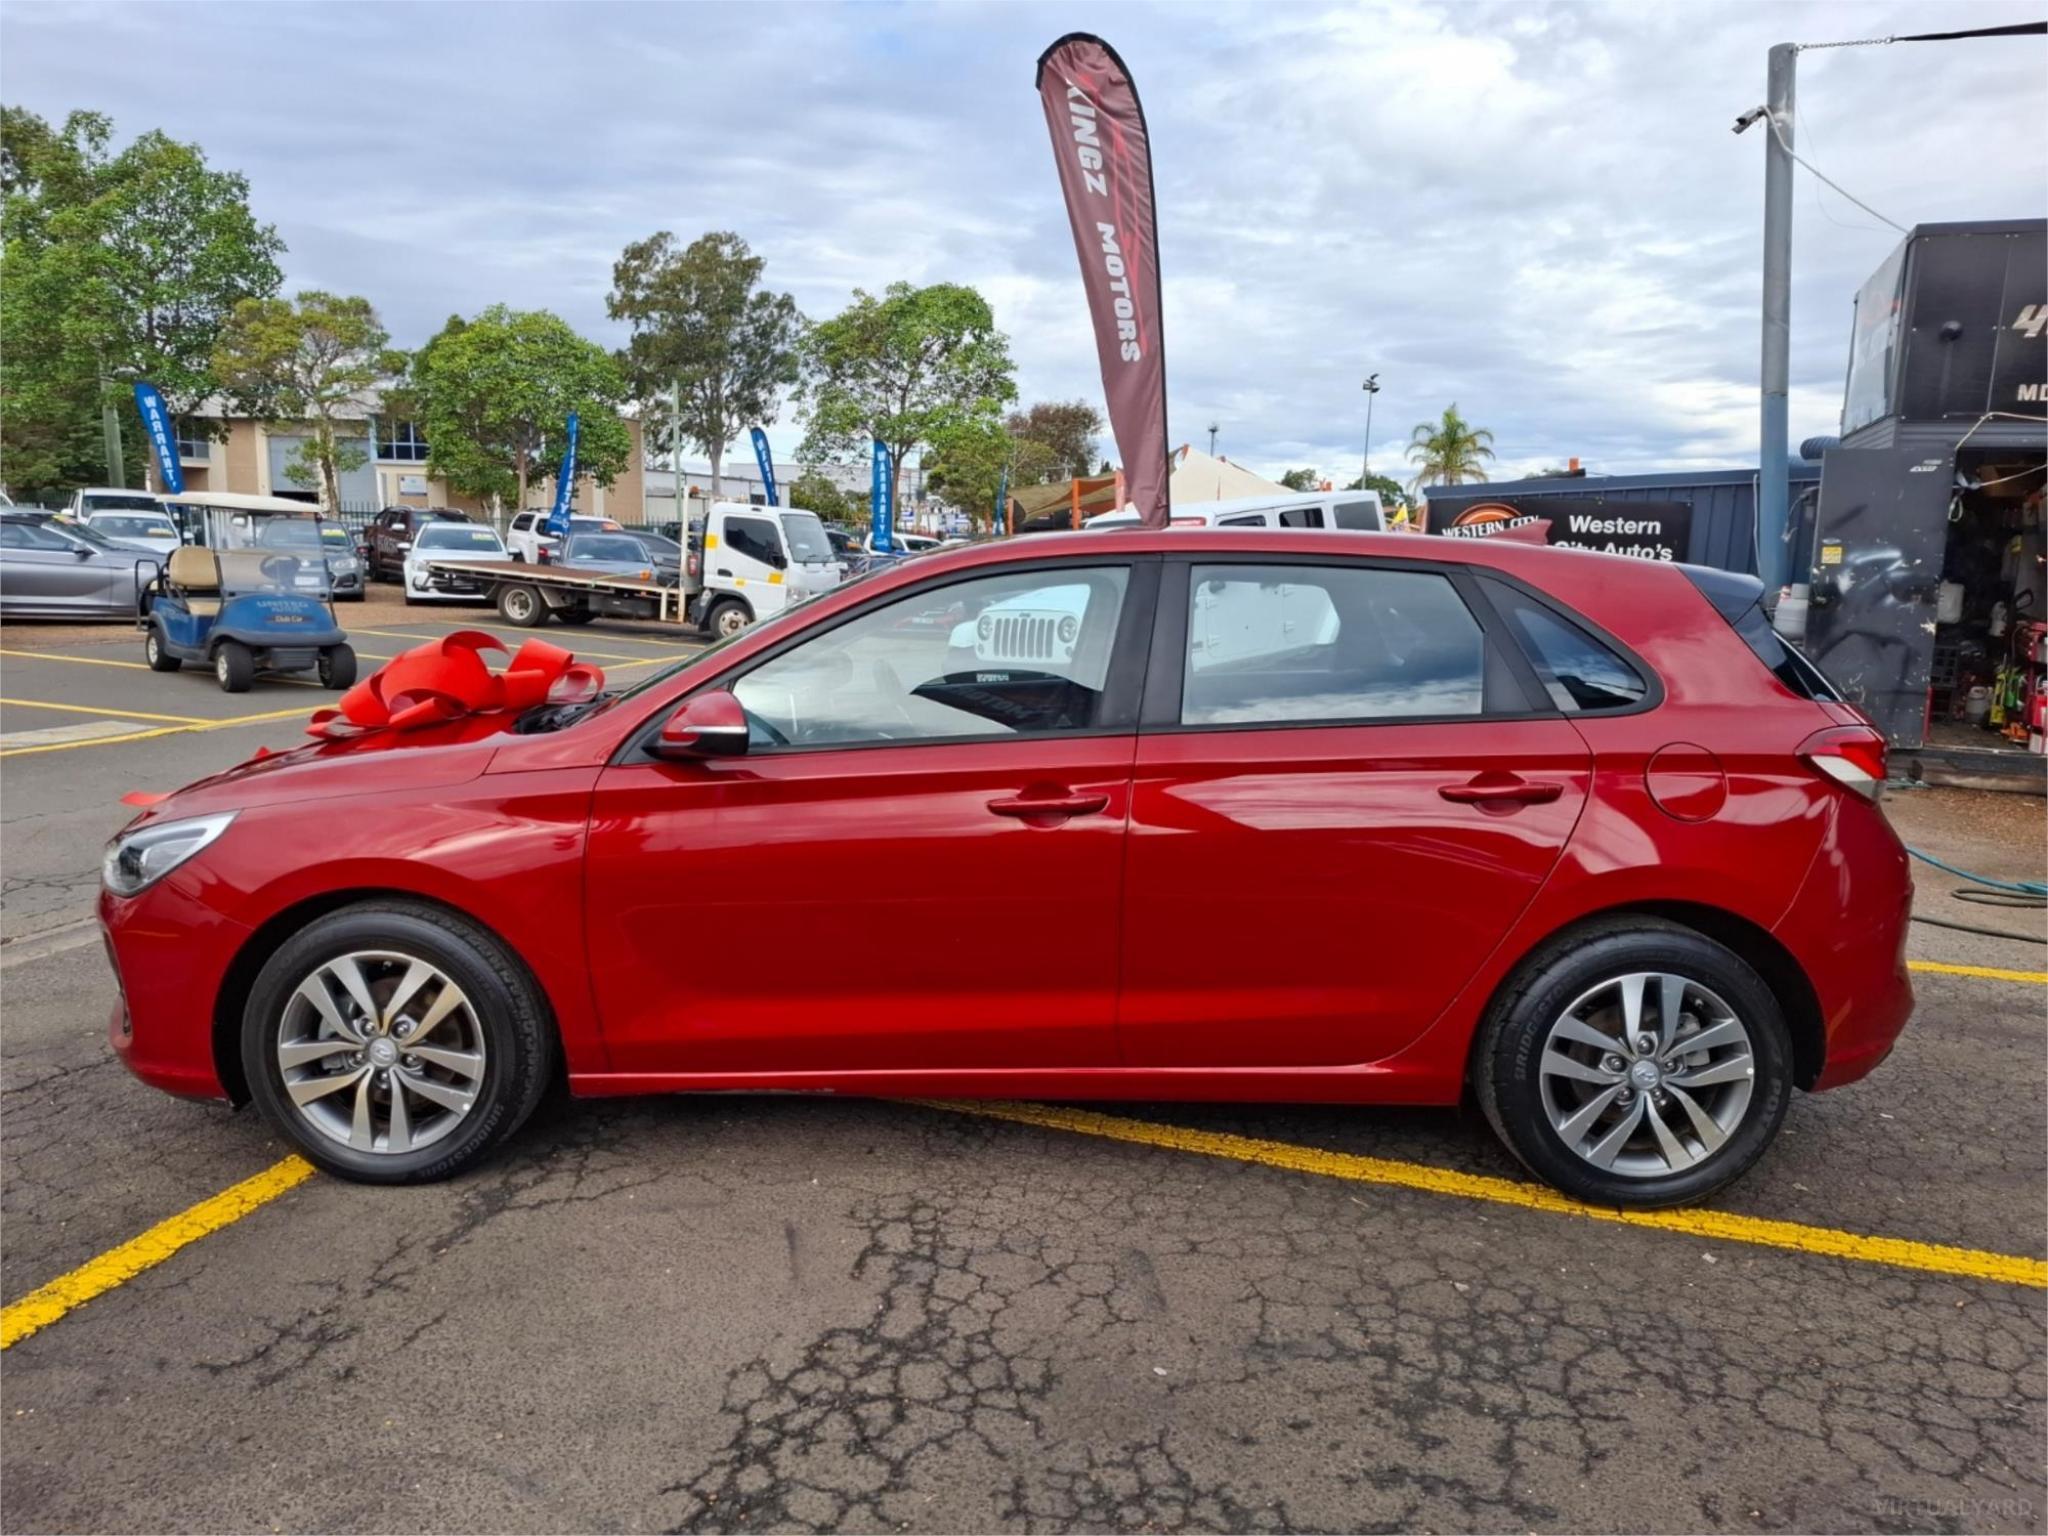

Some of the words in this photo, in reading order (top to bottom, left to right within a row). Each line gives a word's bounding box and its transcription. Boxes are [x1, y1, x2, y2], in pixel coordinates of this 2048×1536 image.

[1096, 221, 1142, 363] MOTORS
[2012, 304, 2048, 338] 4
[876, 450, 887, 534] WARRANTY
[1441, 520, 1504, 538] WESTERN
[1569, 514, 1661, 535] Western
[1604, 541, 1673, 561] Auto's
[1514, 976, 1573, 1081] BRIDGESTO
